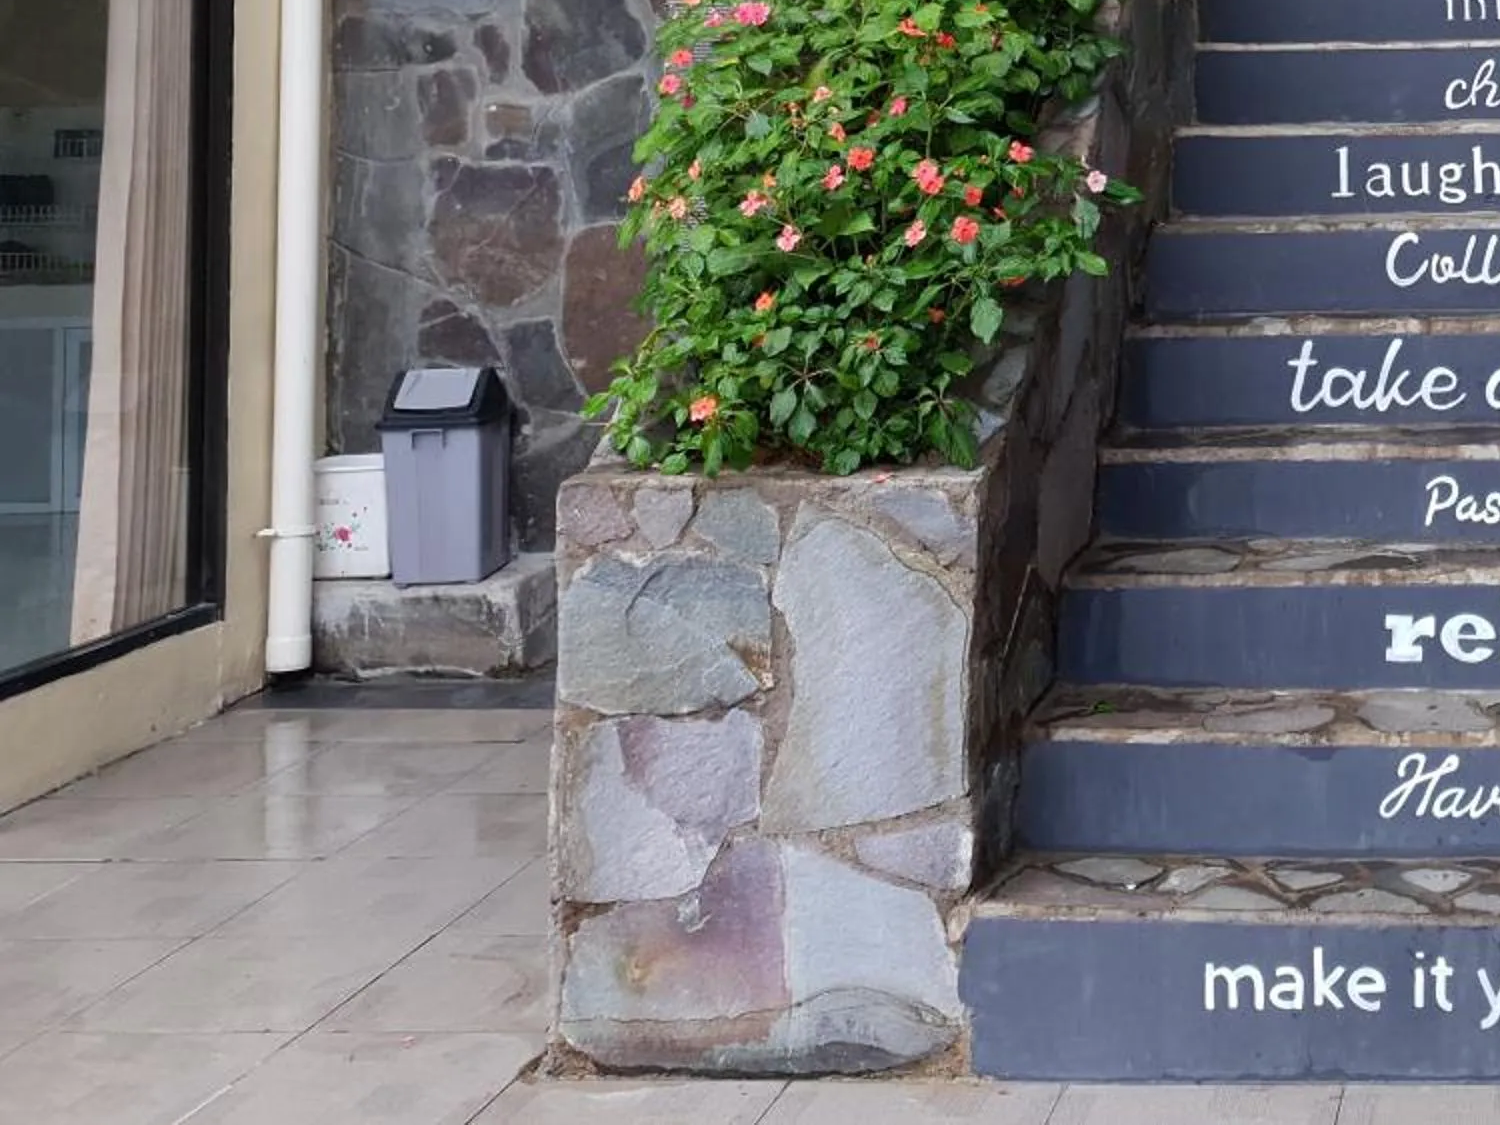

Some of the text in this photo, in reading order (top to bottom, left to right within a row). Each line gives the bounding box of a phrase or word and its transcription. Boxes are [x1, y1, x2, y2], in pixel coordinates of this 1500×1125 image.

[1286, 337, 1468, 413] take
[1203, 945, 1388, 1013] make
[1412, 950, 1456, 1013] it
